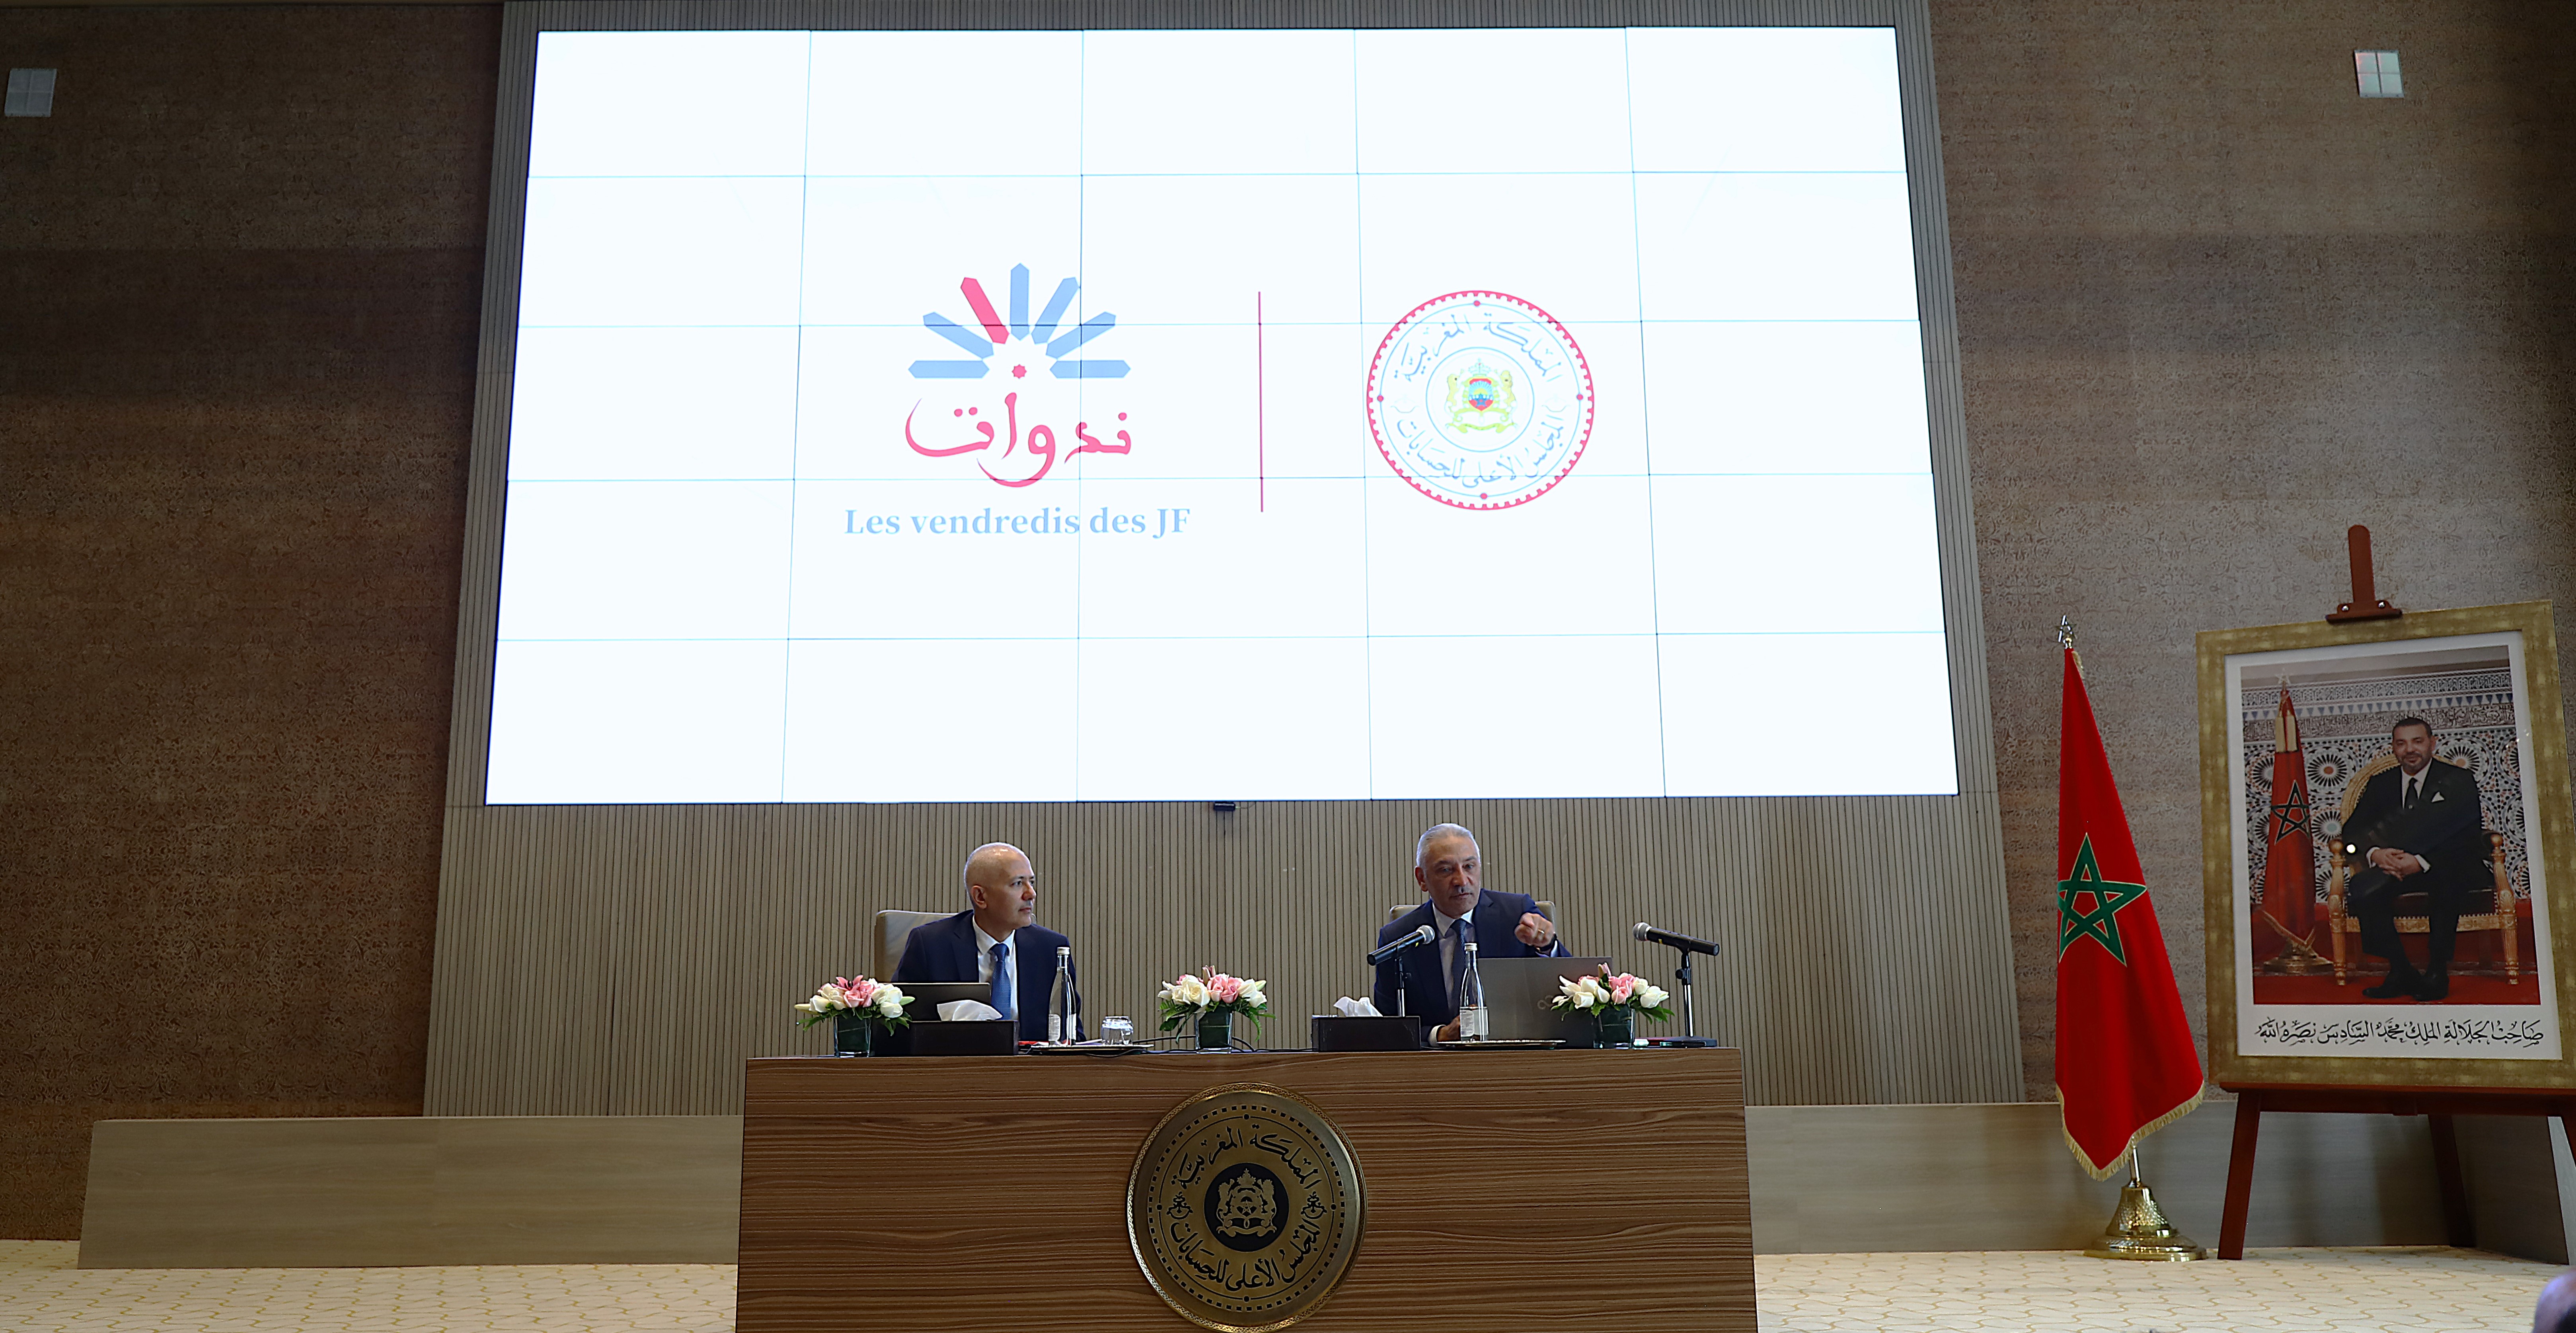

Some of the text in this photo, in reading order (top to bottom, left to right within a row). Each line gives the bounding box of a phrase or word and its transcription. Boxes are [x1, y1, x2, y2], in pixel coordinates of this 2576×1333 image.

[905, 392, 1131, 488] ندوات
[844, 507, 1191, 539] Les vendredis des JF
[1249, 1124, 1322, 1190] المملكة
[1171, 1222, 1230, 1284] للحسابات
[1225, 1257, 1280, 1291] الأعلى
